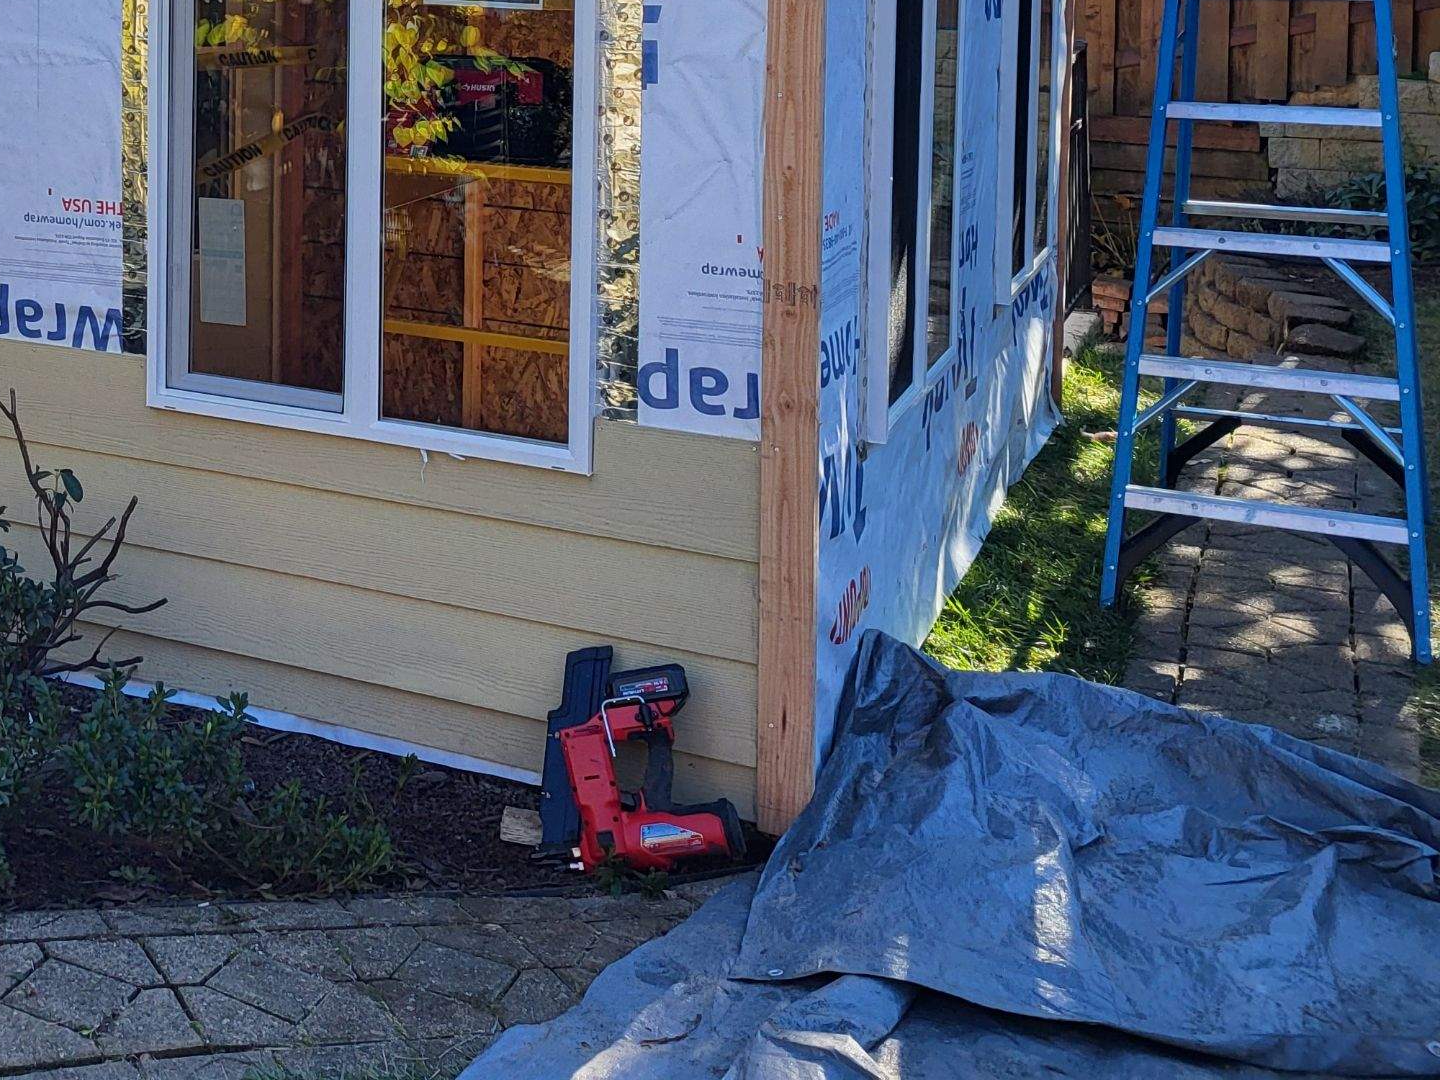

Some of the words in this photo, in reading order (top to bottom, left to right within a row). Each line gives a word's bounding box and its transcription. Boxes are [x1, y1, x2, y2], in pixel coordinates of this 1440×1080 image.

[217, 49, 279, 67] CAUTION
[203, 143, 263, 177] CAUTION
[61, 198, 92, 214] USA
